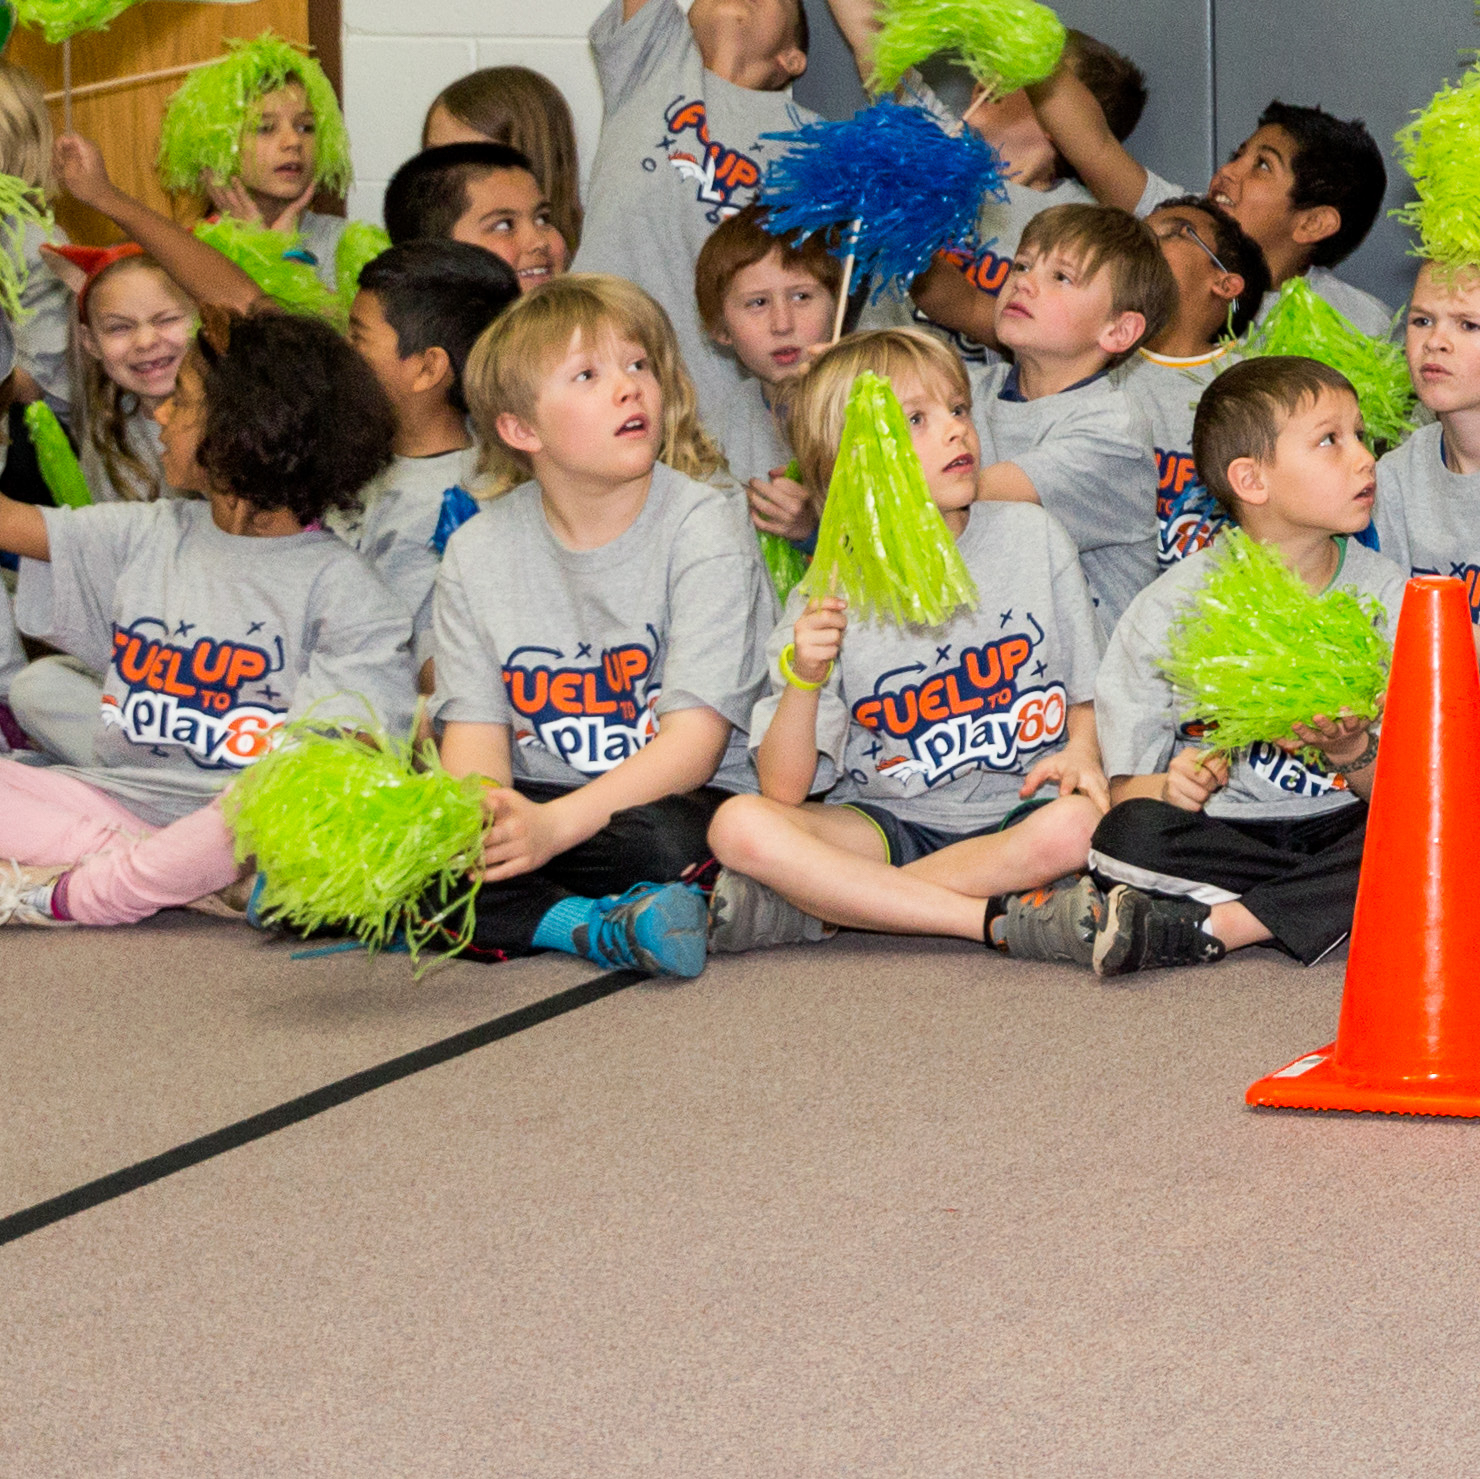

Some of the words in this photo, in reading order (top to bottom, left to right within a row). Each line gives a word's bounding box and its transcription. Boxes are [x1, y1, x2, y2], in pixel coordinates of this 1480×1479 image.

[191, 640, 267, 688] UP
[501, 669, 618, 715] UEL
[602, 648, 649, 693] UP
[200, 688, 231, 711] TO
[855, 674, 985, 735] FUEL
[964, 638, 1030, 689] UP
[987, 687, 1012, 709] TO
[619, 700, 637, 720] TO
